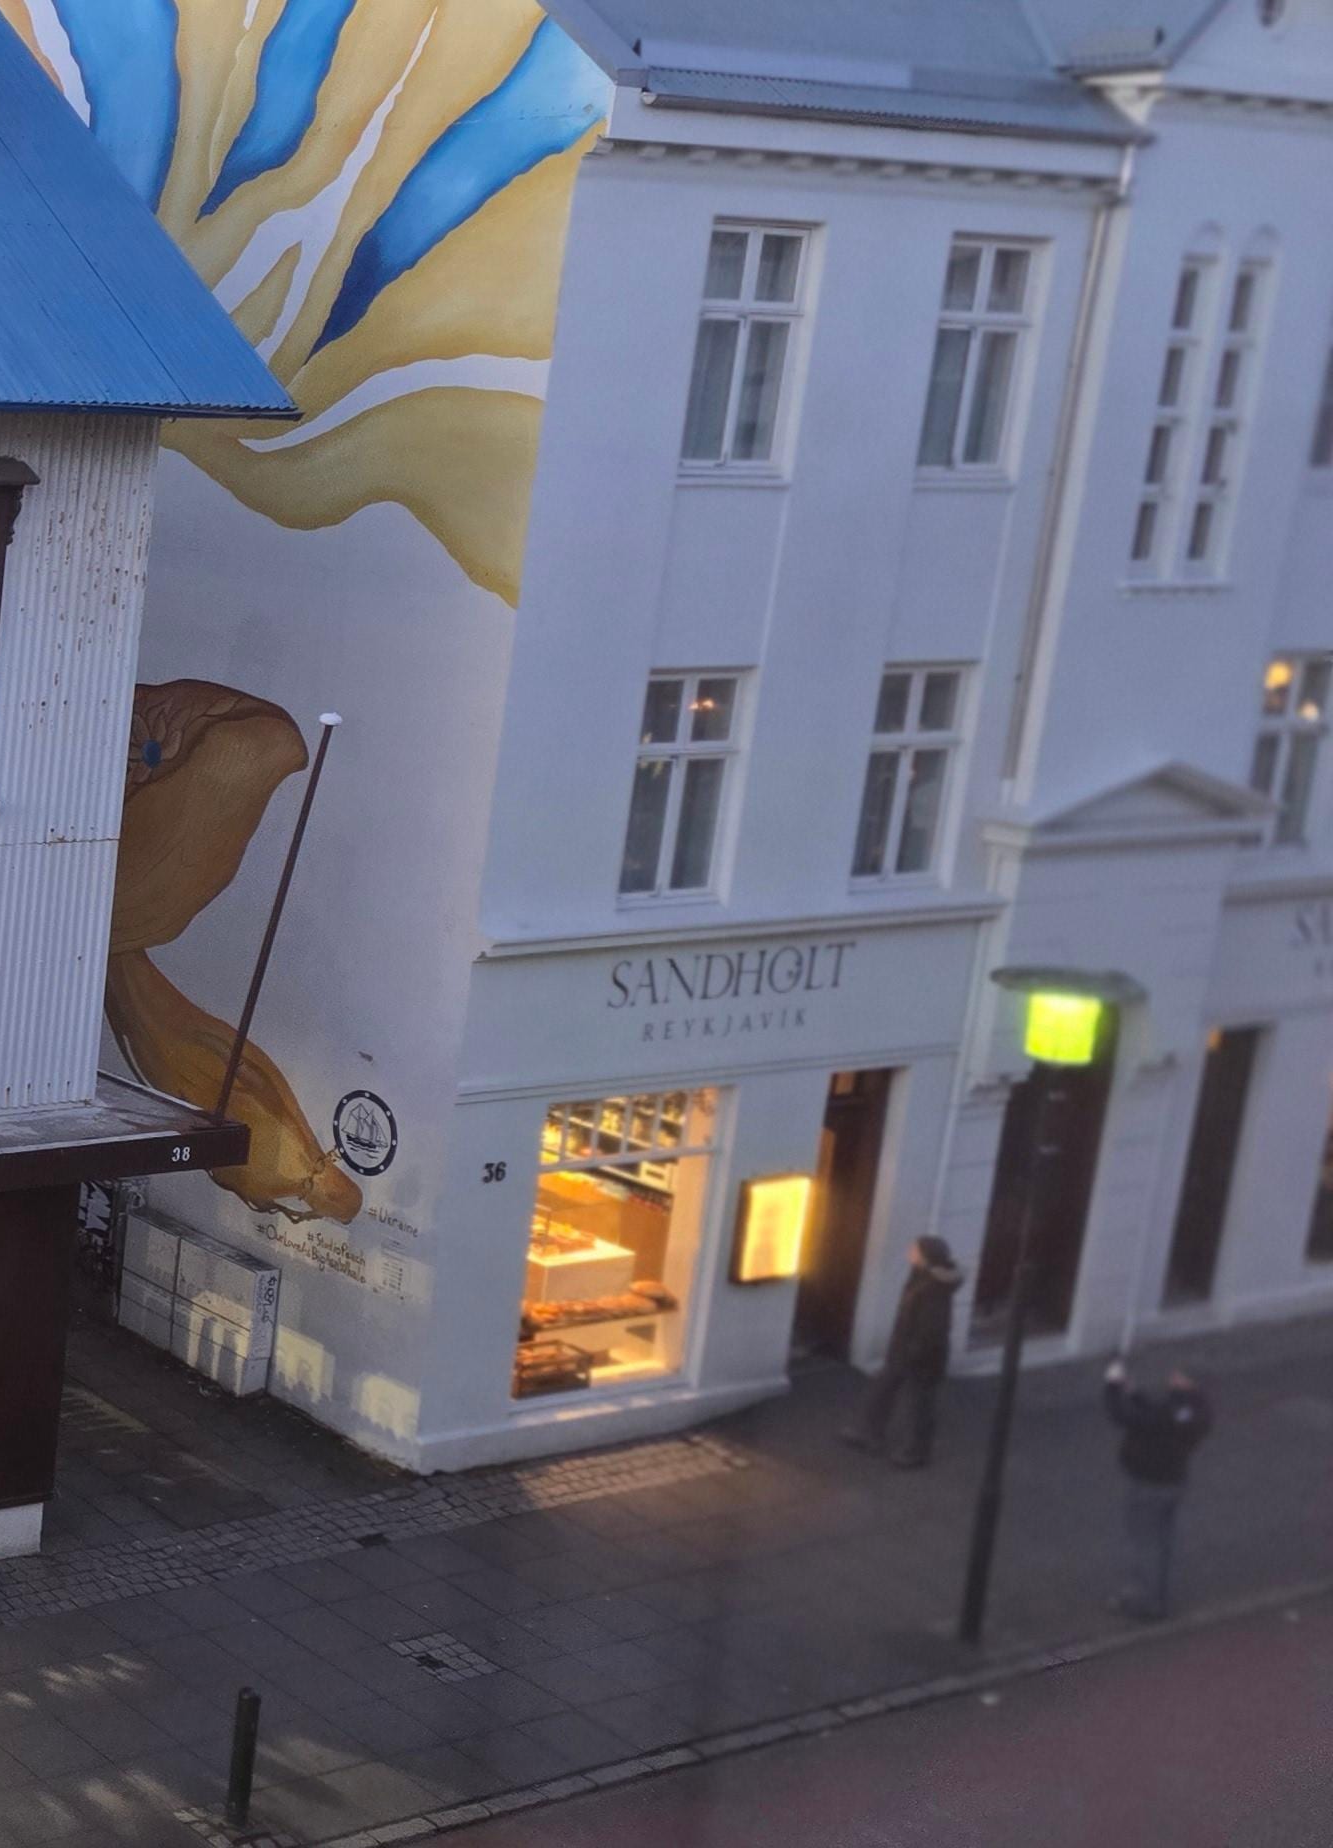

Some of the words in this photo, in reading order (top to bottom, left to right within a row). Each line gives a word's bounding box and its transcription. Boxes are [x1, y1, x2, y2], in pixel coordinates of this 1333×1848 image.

[607, 941, 856, 1010] SANDHOLT
[171, 1146, 191, 1162] 38
[482, 1161, 508, 1184] 36
